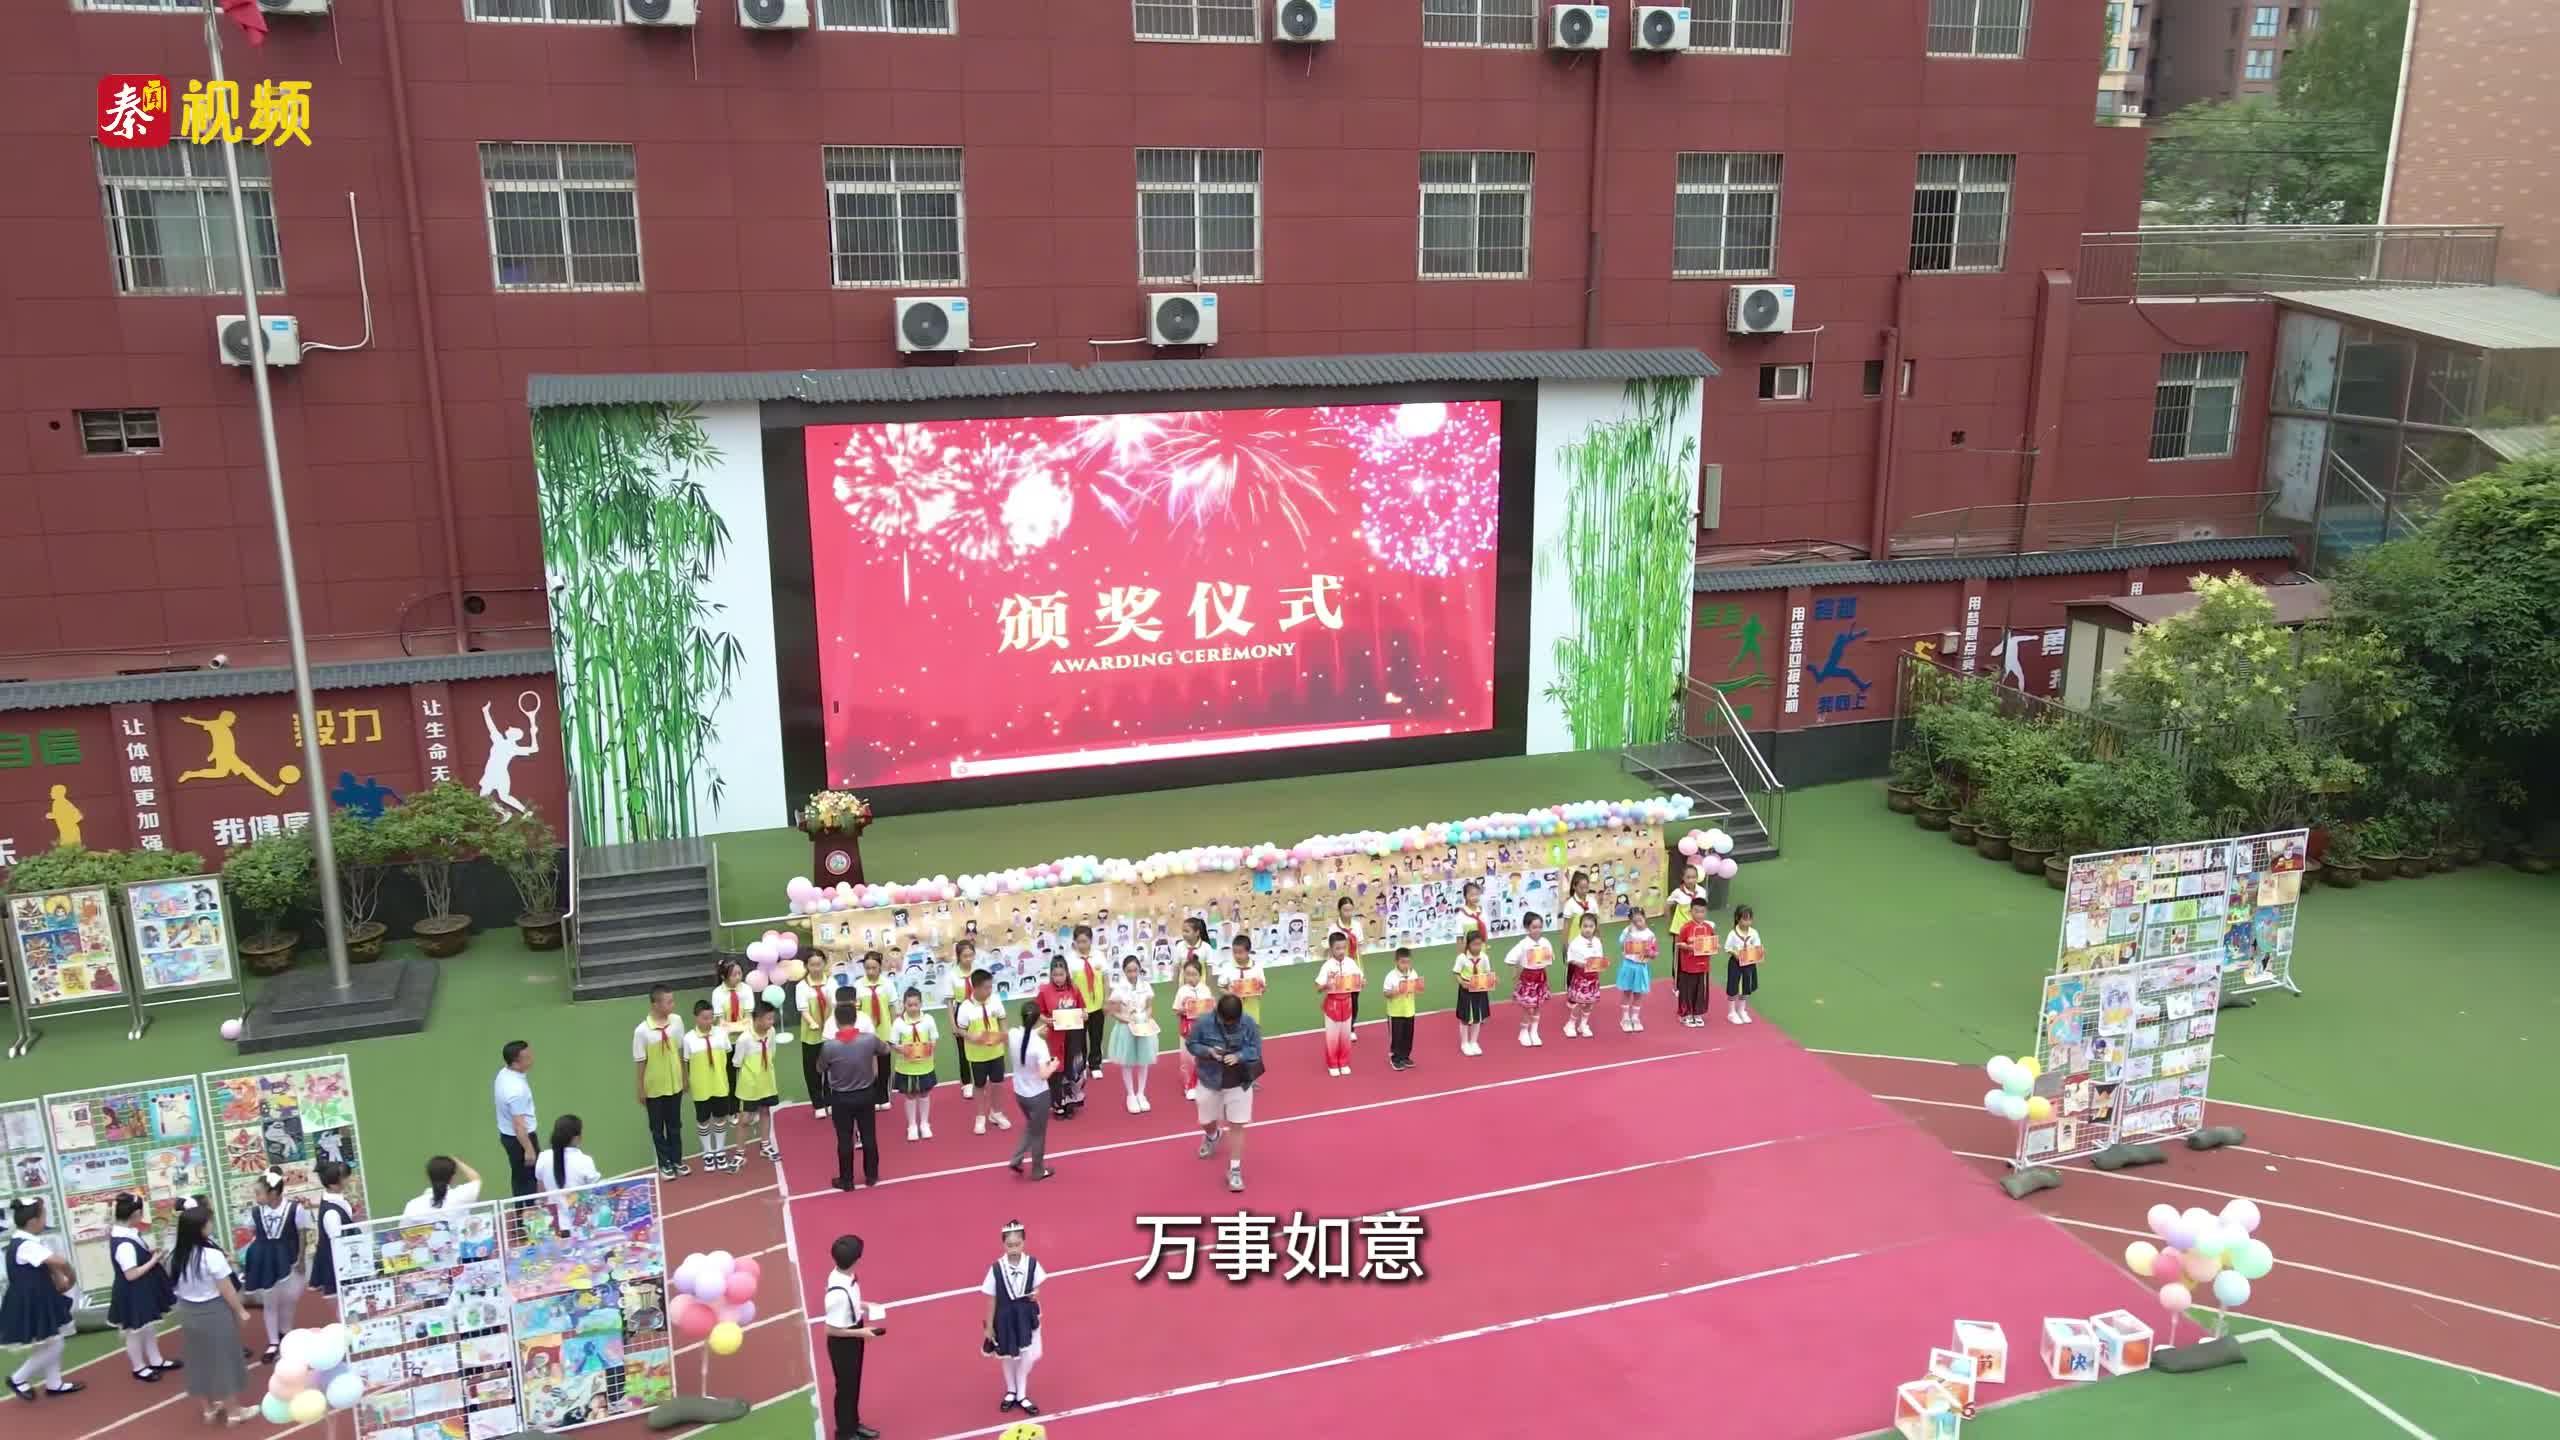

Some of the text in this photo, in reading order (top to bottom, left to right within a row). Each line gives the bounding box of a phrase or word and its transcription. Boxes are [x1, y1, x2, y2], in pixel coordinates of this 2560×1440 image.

[997, 574, 1344, 653] 颁奖仪式
[1050, 642, 1296, 674] AWARDING CEREMONY
[422, 699, 450, 782] 让生命无
